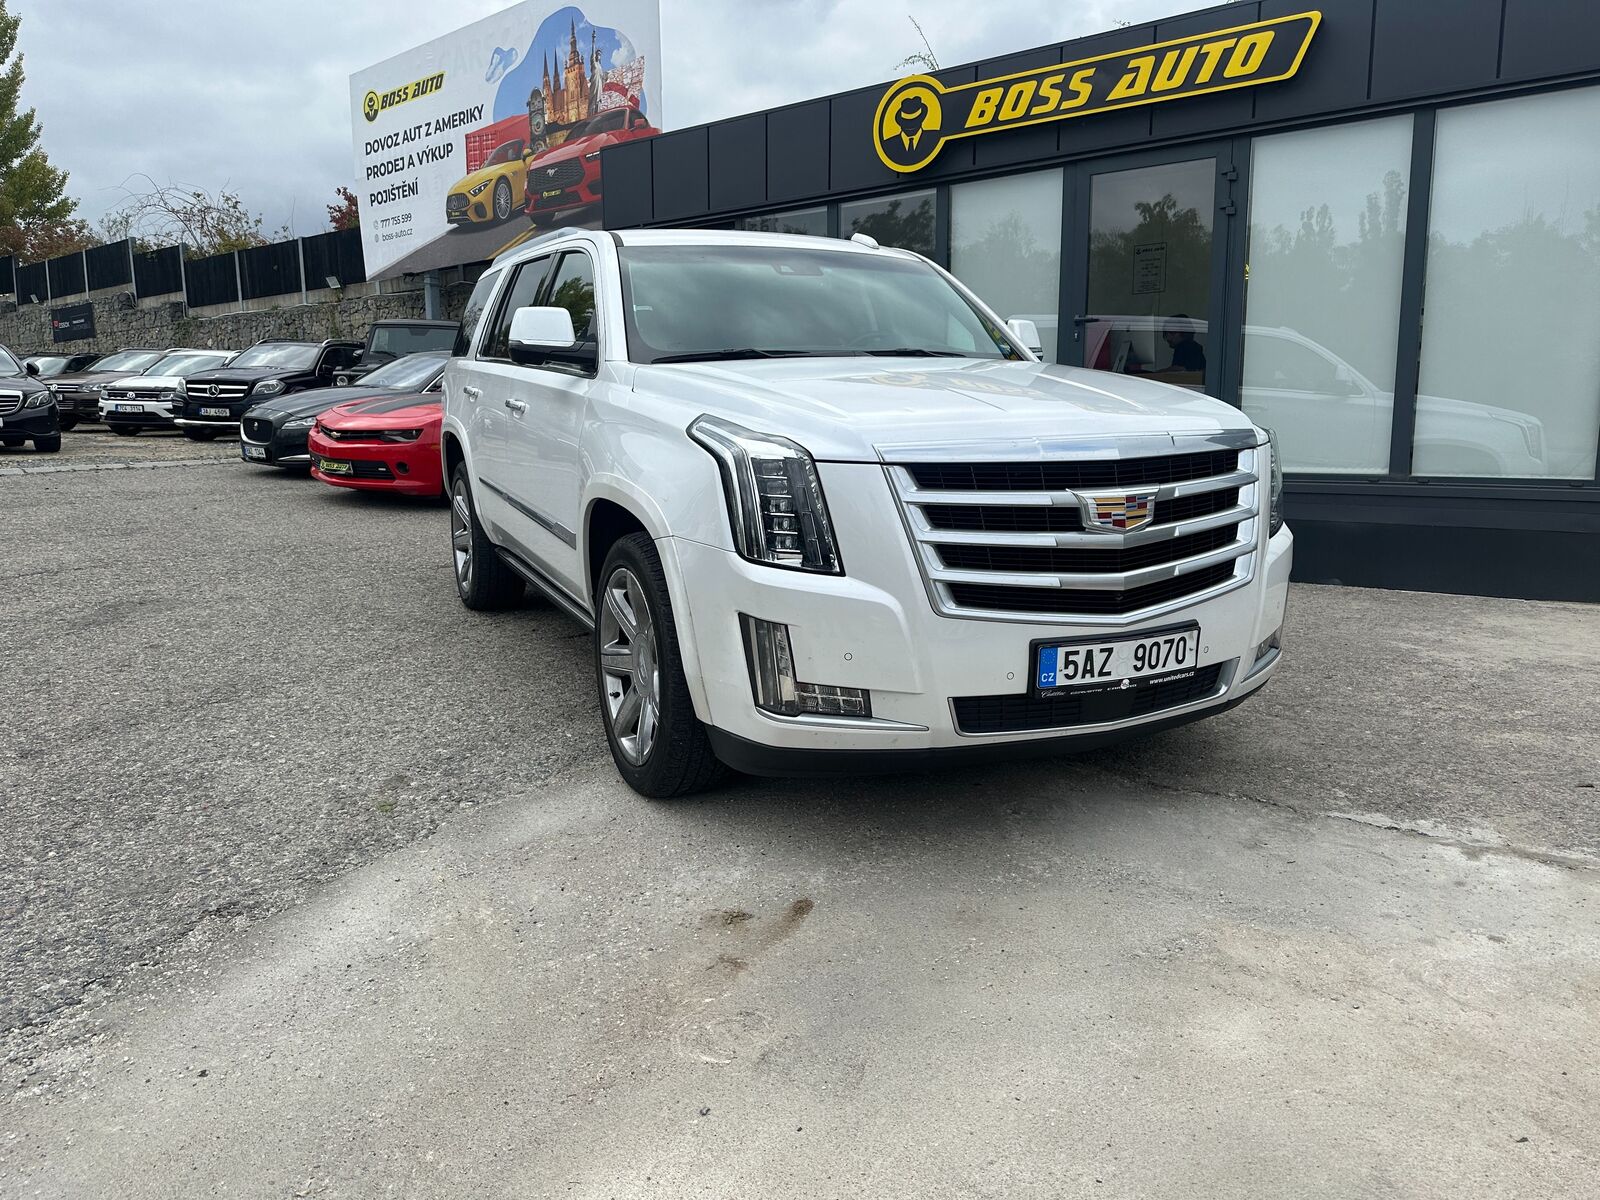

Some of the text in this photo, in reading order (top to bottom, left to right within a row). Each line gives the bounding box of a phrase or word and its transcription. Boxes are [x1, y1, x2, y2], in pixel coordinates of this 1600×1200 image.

[381, 73, 445, 110] BOSS AUTO
[965, 30, 1276, 129] BOSS AUTO
[365, 103, 485, 156] DOVOZ AUT Z AMERIKY
[366, 142, 454, 181] PRODEJ A VÝKUP
[369, 176, 419, 207] POJIŠTĚNÍ
[380, 218, 391, 229] 777
[401, 212, 412, 224] 599
[381, 228, 413, 242] boss-auto.cz
[1063, 636, 1187, 680] 5AZ 9070
[1041, 672, 1055, 683] CZ
